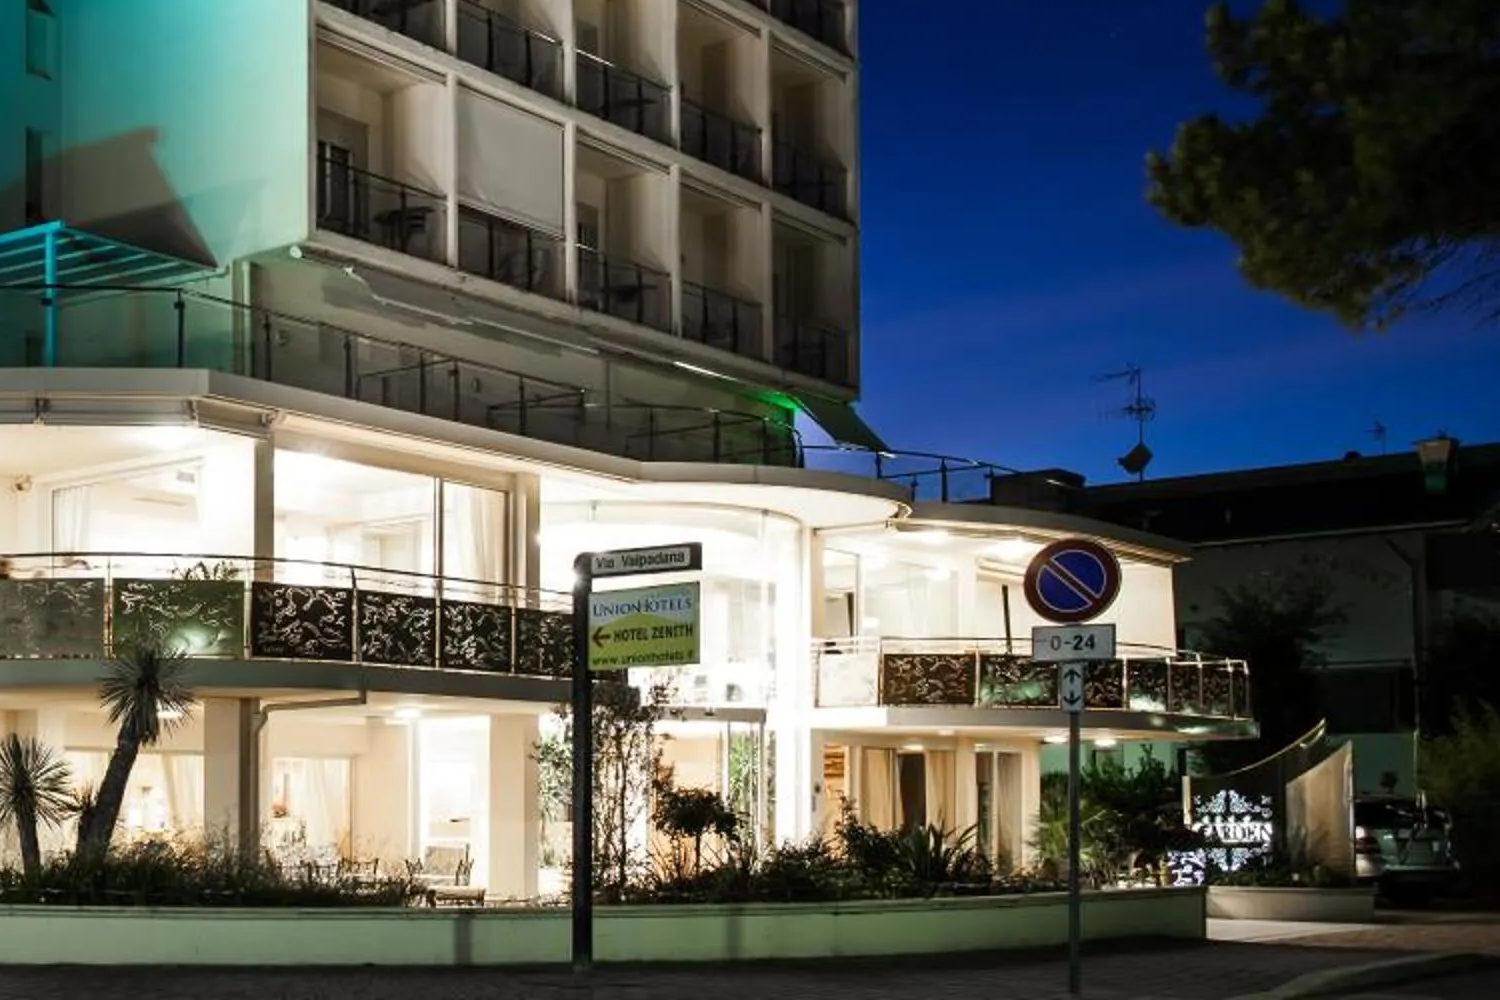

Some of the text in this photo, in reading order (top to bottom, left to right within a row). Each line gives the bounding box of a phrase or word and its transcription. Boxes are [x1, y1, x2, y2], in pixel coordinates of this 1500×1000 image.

[595, 557, 615, 569] Via
[613, 623, 694, 642] HOTEL ZENITH
